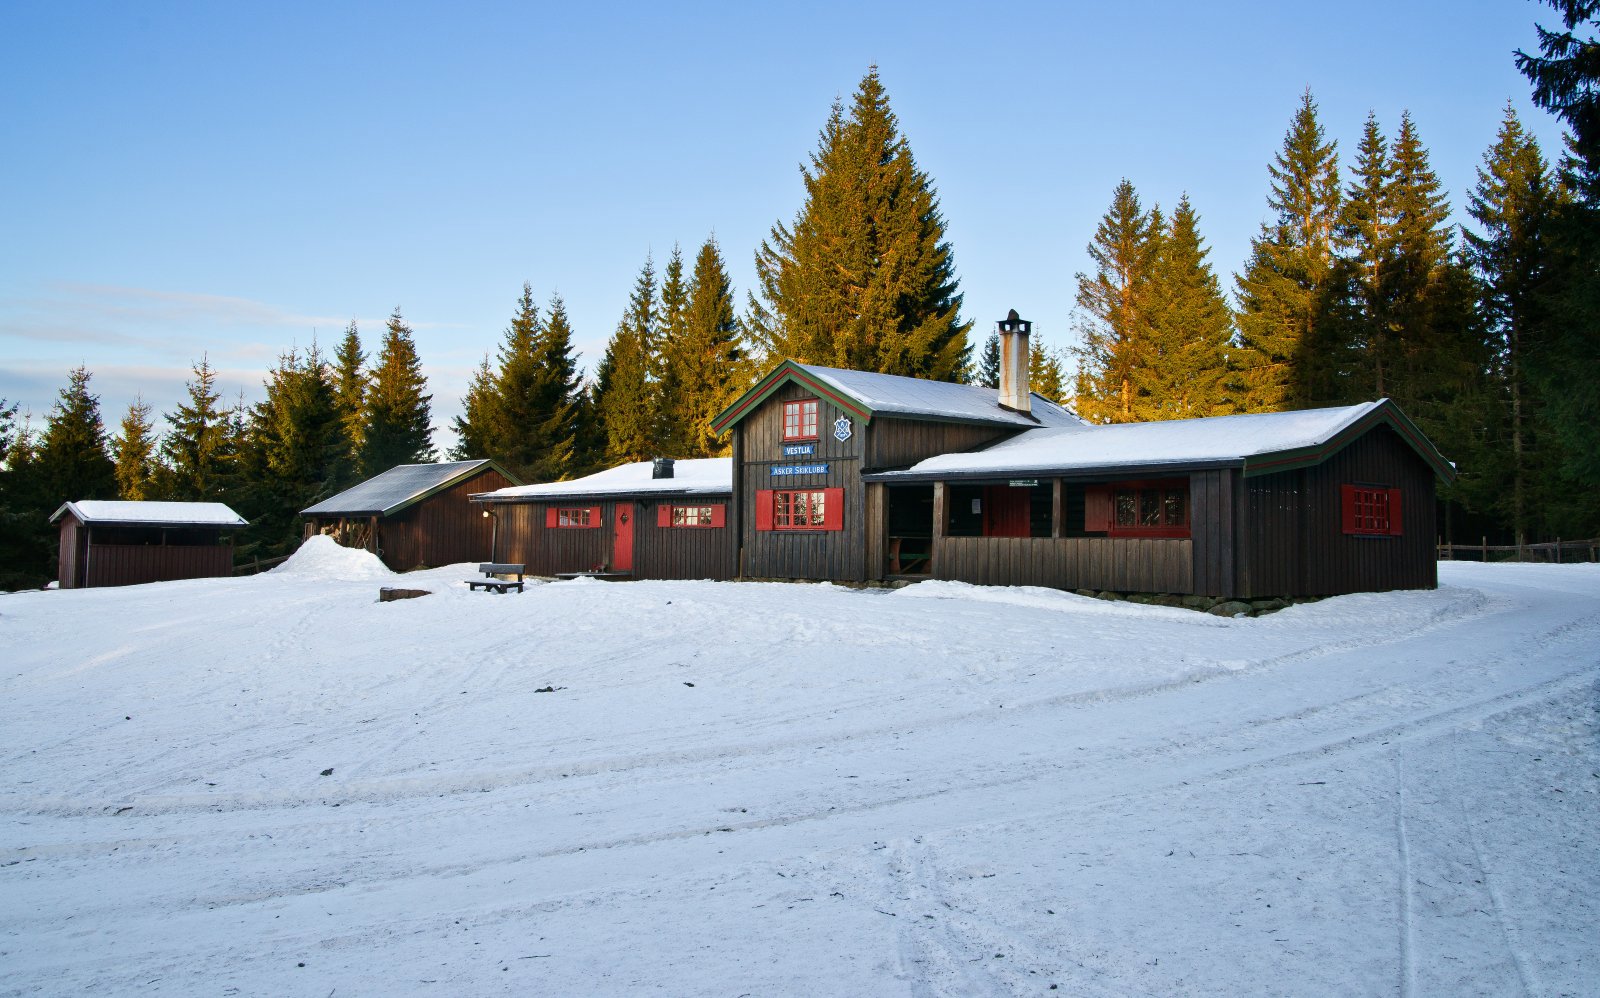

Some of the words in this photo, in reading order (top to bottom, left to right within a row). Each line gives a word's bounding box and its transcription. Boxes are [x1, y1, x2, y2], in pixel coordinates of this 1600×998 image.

[786, 446, 811, 455] VESTLIA
[773, 467, 793, 475] ASKER
[794, 466, 825, 474] SKIKLUBB
